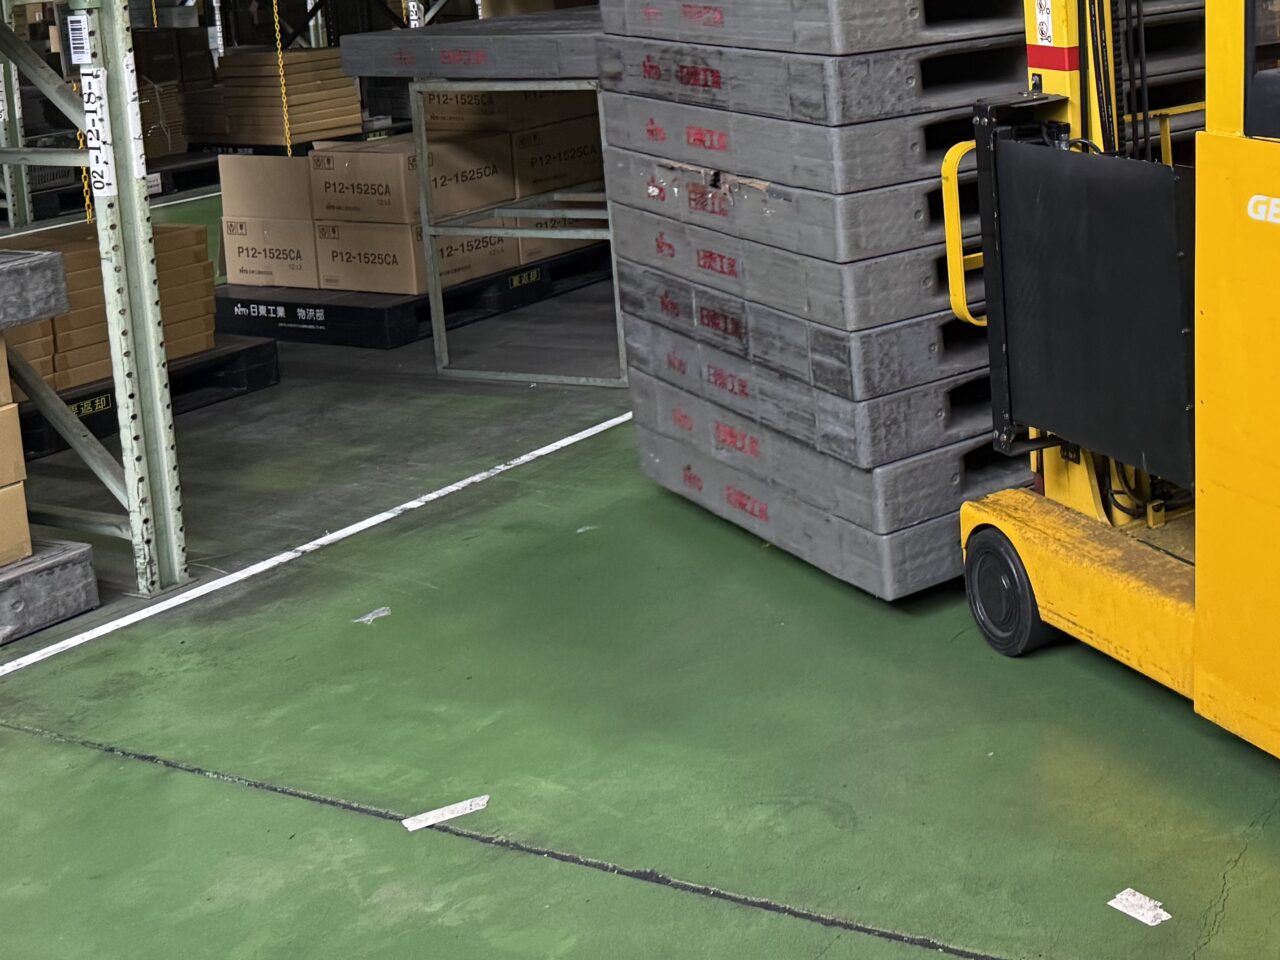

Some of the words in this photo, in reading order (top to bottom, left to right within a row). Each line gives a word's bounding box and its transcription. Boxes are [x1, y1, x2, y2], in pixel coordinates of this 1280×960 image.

[81, 72, 105, 190] 02-12-18-1
[324, 181, 391, 196] P12-1525CA
[237, 246, 302, 261] P12-1525CA
[332, 250, 398, 266] P12-1525CA
